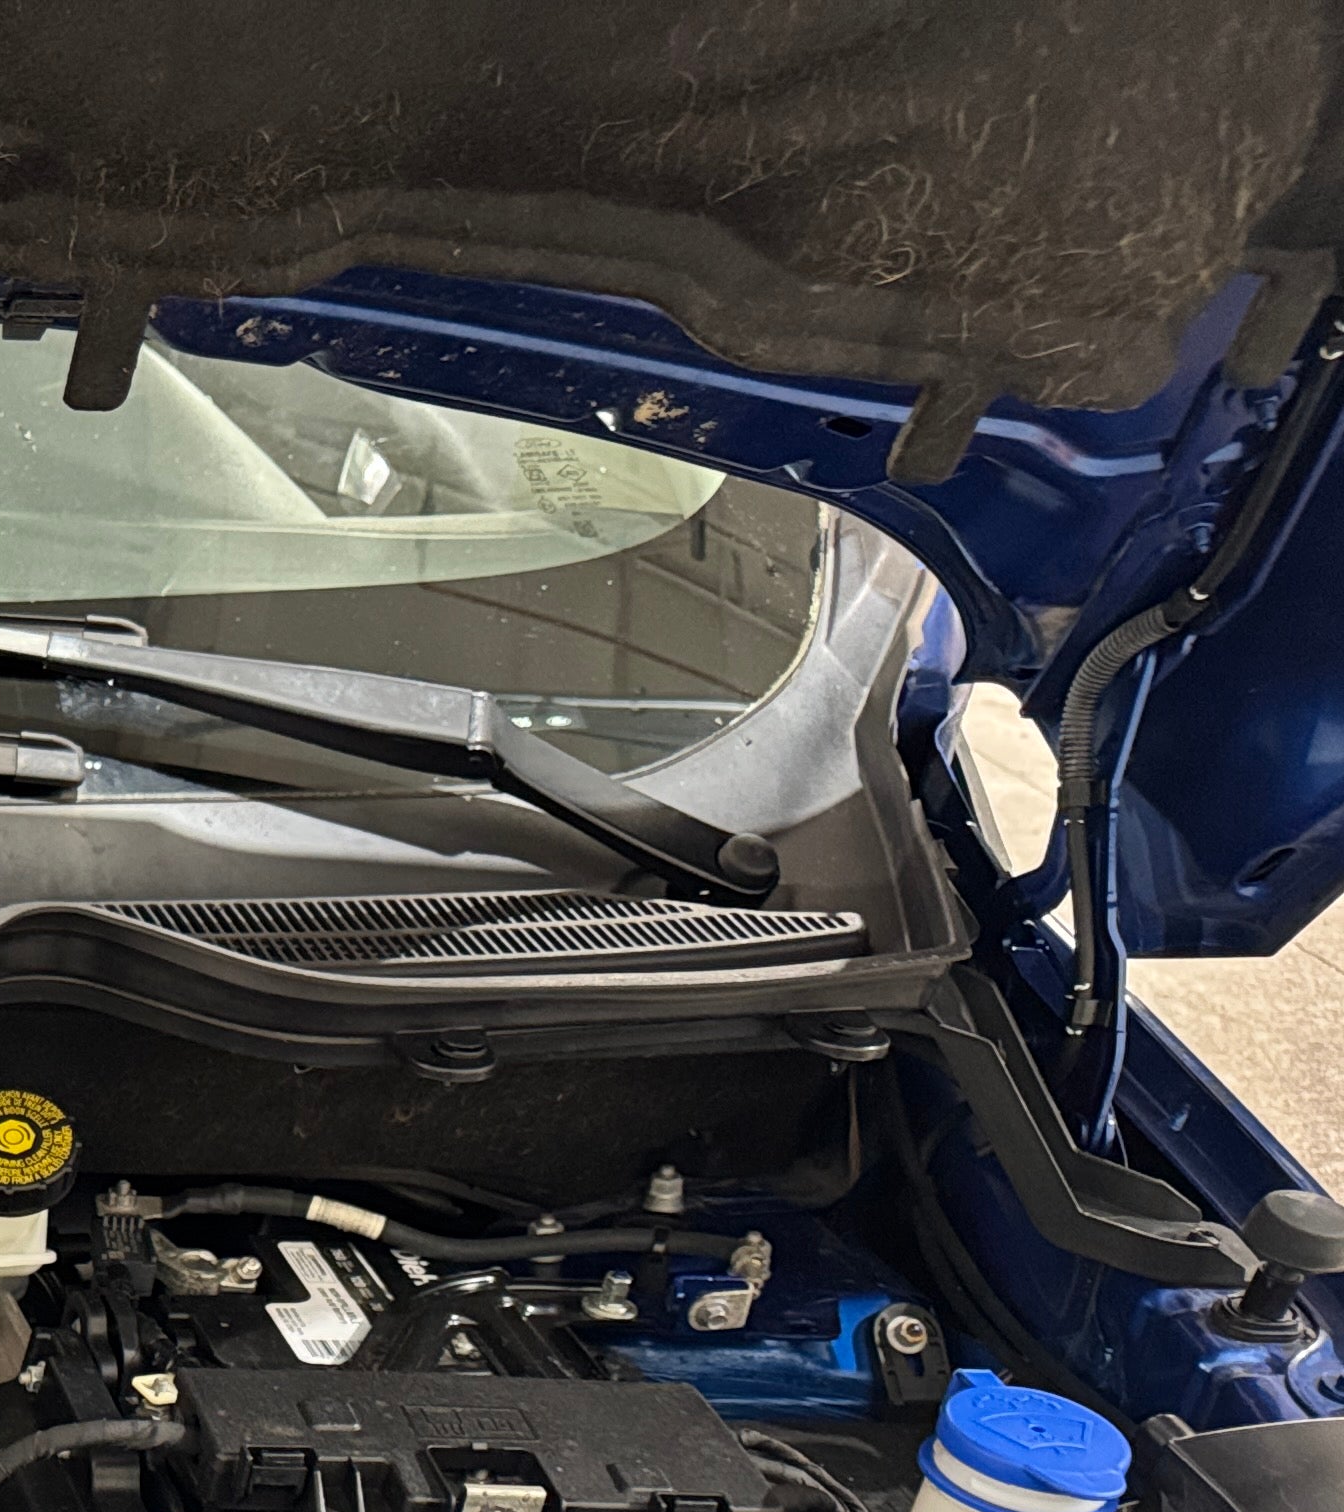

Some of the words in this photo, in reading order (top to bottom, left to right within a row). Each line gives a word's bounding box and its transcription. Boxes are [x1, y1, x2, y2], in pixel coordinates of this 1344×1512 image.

[24, 1147, 47, 1165] CLEAN
[11, 1175, 33, 1184] FROM
[39, 1158, 64, 1177] SEALED
